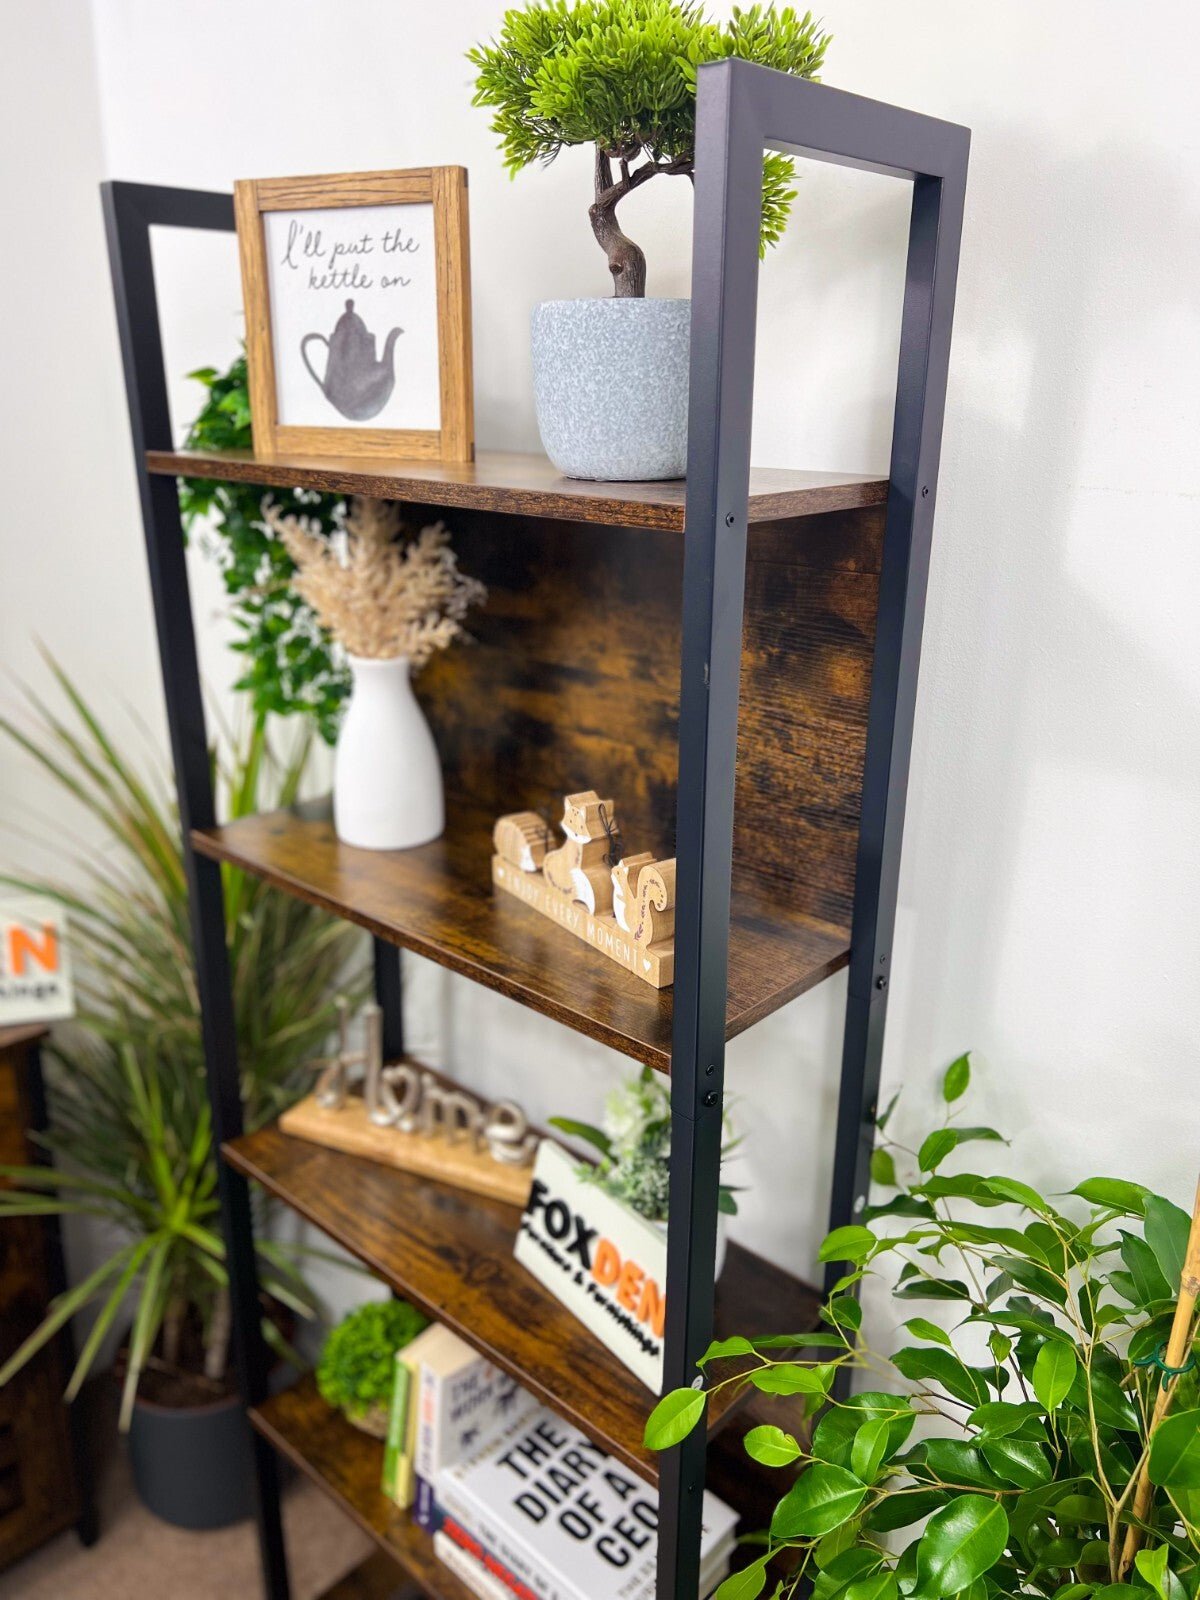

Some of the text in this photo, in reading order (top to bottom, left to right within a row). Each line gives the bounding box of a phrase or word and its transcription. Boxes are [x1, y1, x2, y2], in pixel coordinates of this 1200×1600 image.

[281, 219, 420, 269] I'll put the
[308, 263, 411, 290] kettle on
[544, 893, 580, 930] EVERY
[586, 920, 639, 972] MOMENT
[314, 996, 539, 1168] Home
[523, 1178, 666, 1339] FOXDEN
[496, 1420, 568, 1482] THE
[513, 1439, 613, 1524] DIARY
[558, 1471, 640, 1541] OF A
[596, 1498, 659, 1569] CEO
